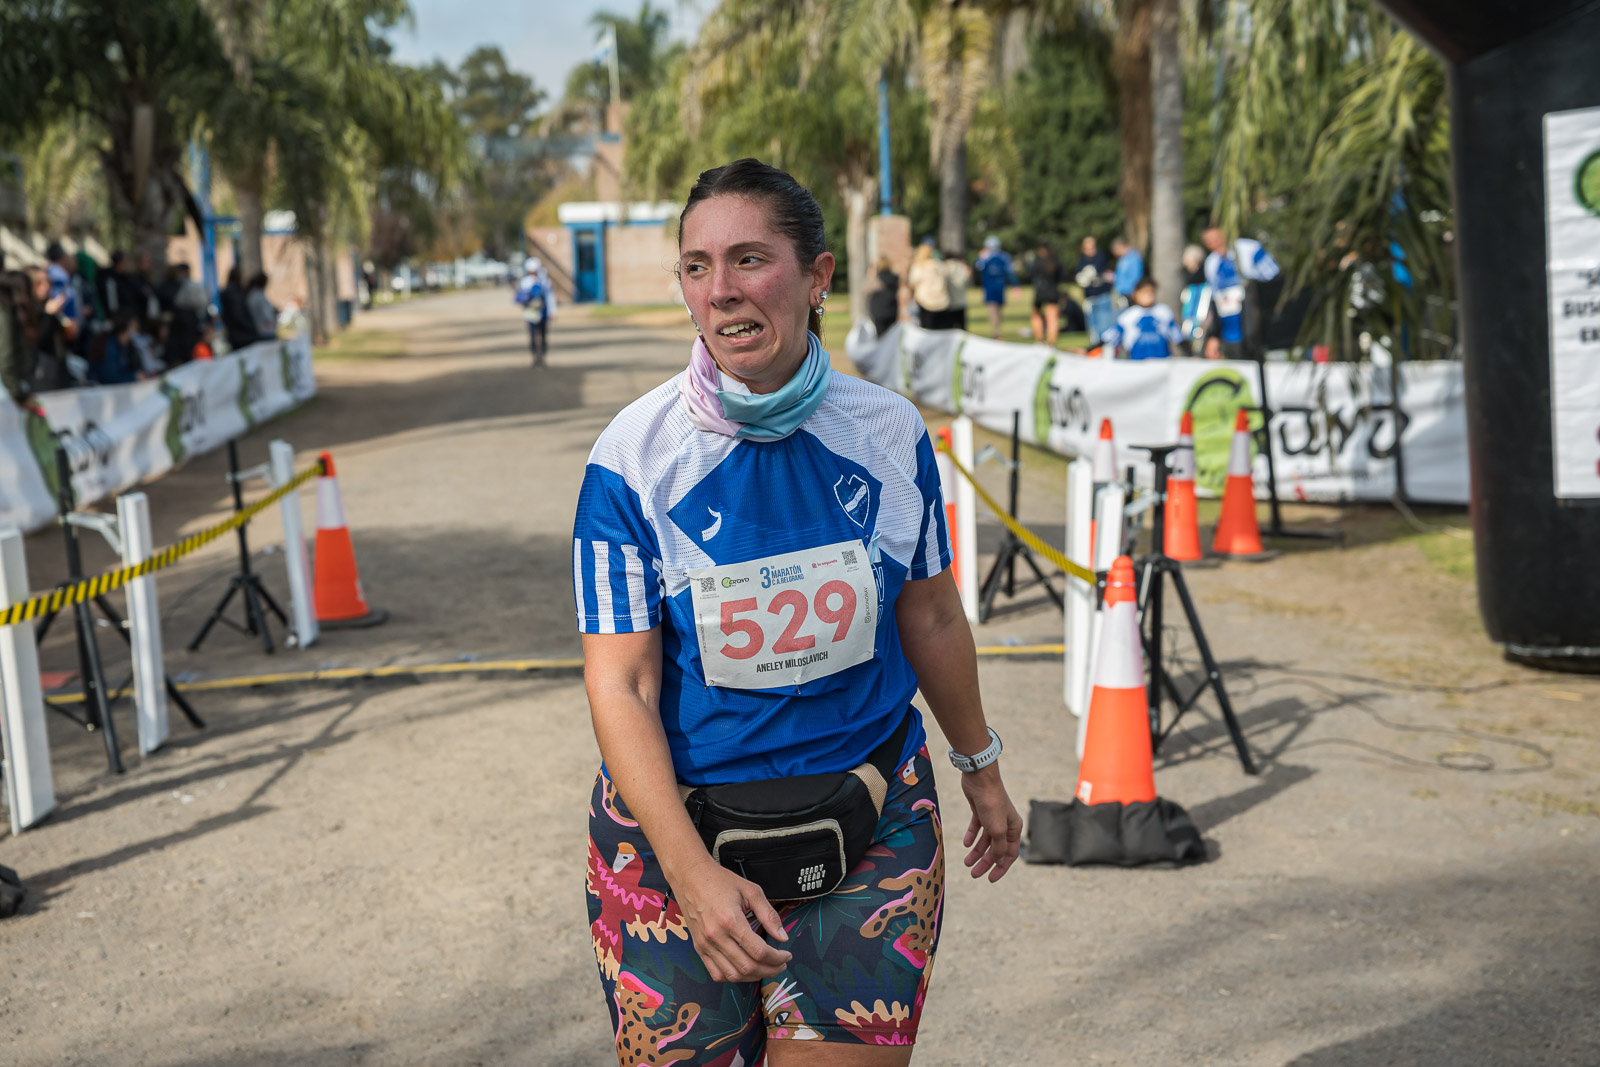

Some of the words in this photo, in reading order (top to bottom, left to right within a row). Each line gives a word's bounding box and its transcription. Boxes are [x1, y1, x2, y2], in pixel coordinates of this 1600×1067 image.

[759, 566, 772, 589] 3
[771, 564, 802, 579] MARATÓN
[720, 579, 858, 660] 529
[756, 661, 783, 673] ANELEY
[784, 650, 829, 669] MILOSLAVICH
[797, 869, 826, 885] STEADY
[800, 863, 824, 877] READY
[801, 879, 823, 892] GROW
